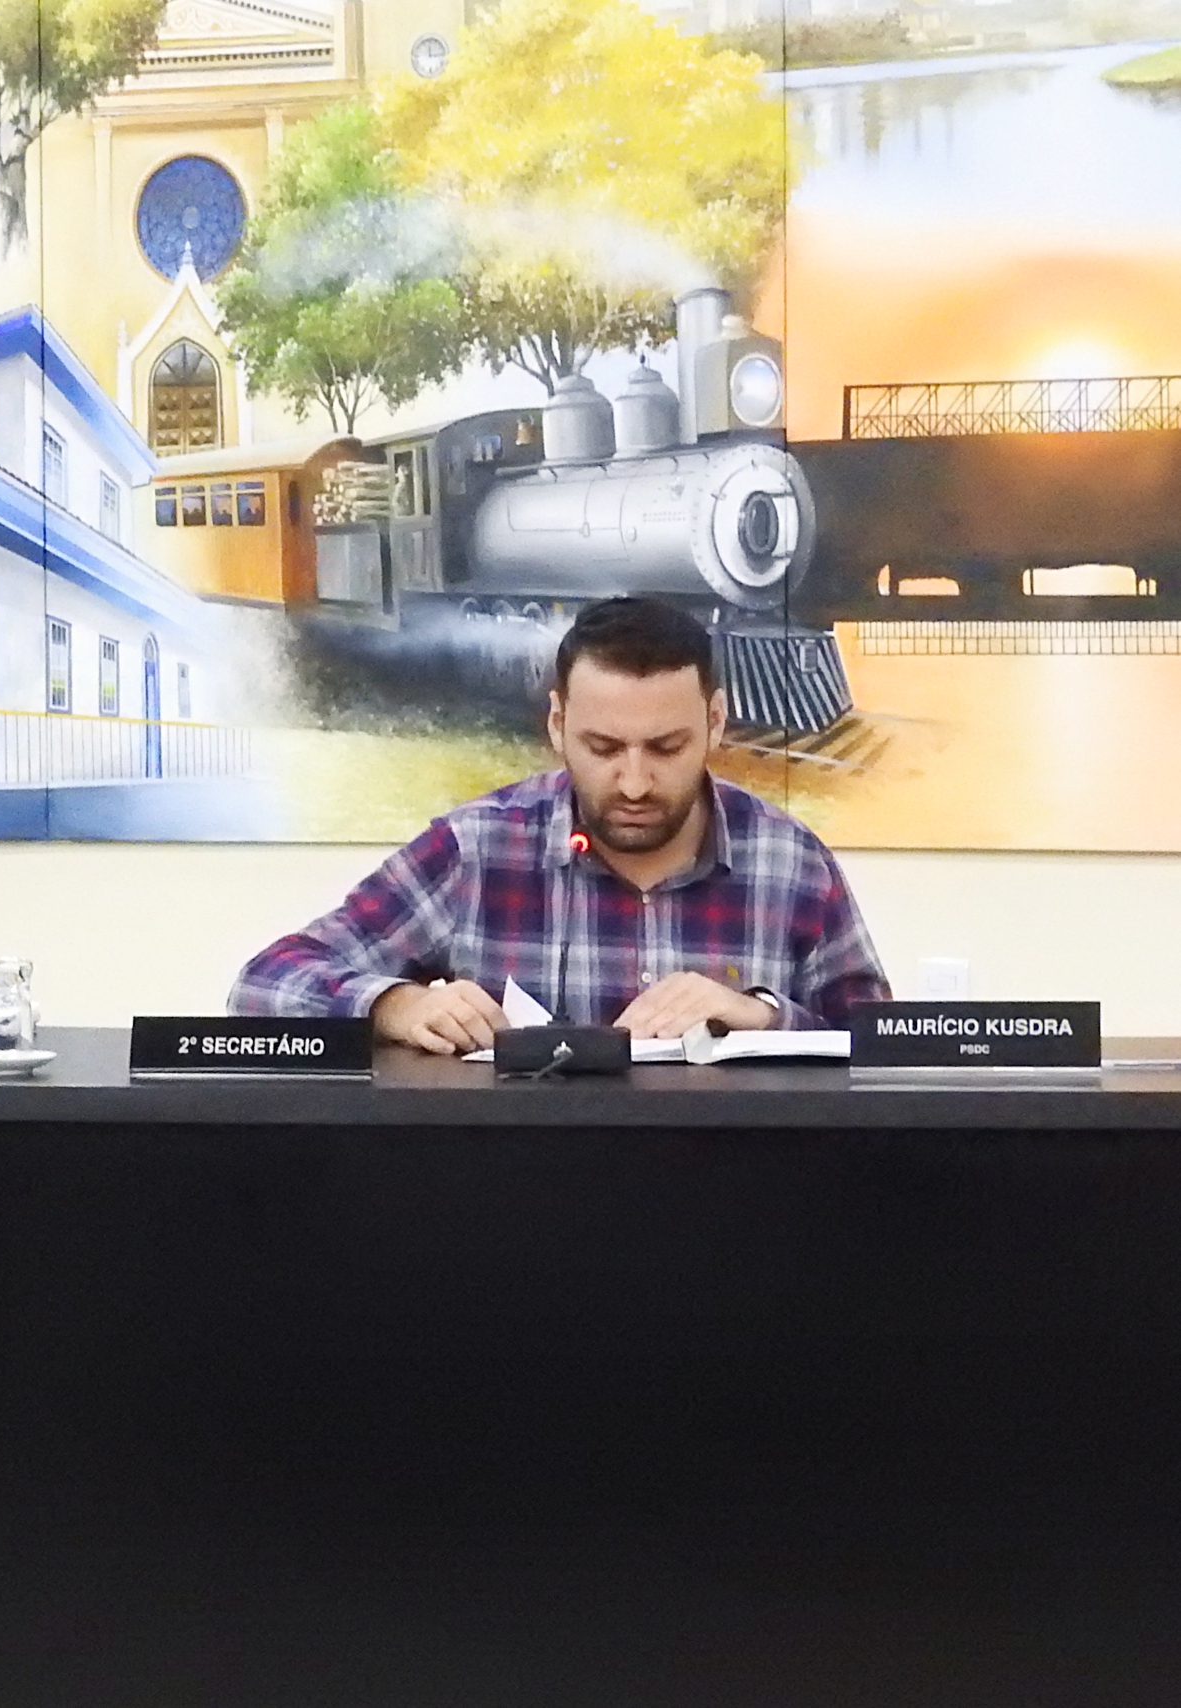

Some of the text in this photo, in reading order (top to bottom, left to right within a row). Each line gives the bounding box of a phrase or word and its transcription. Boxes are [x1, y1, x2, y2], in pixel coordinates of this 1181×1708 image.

[876, 1014, 1073, 1036] MAURÍCIO KUSDRA
[201, 1033, 325, 1056] SECRETÁRIO
